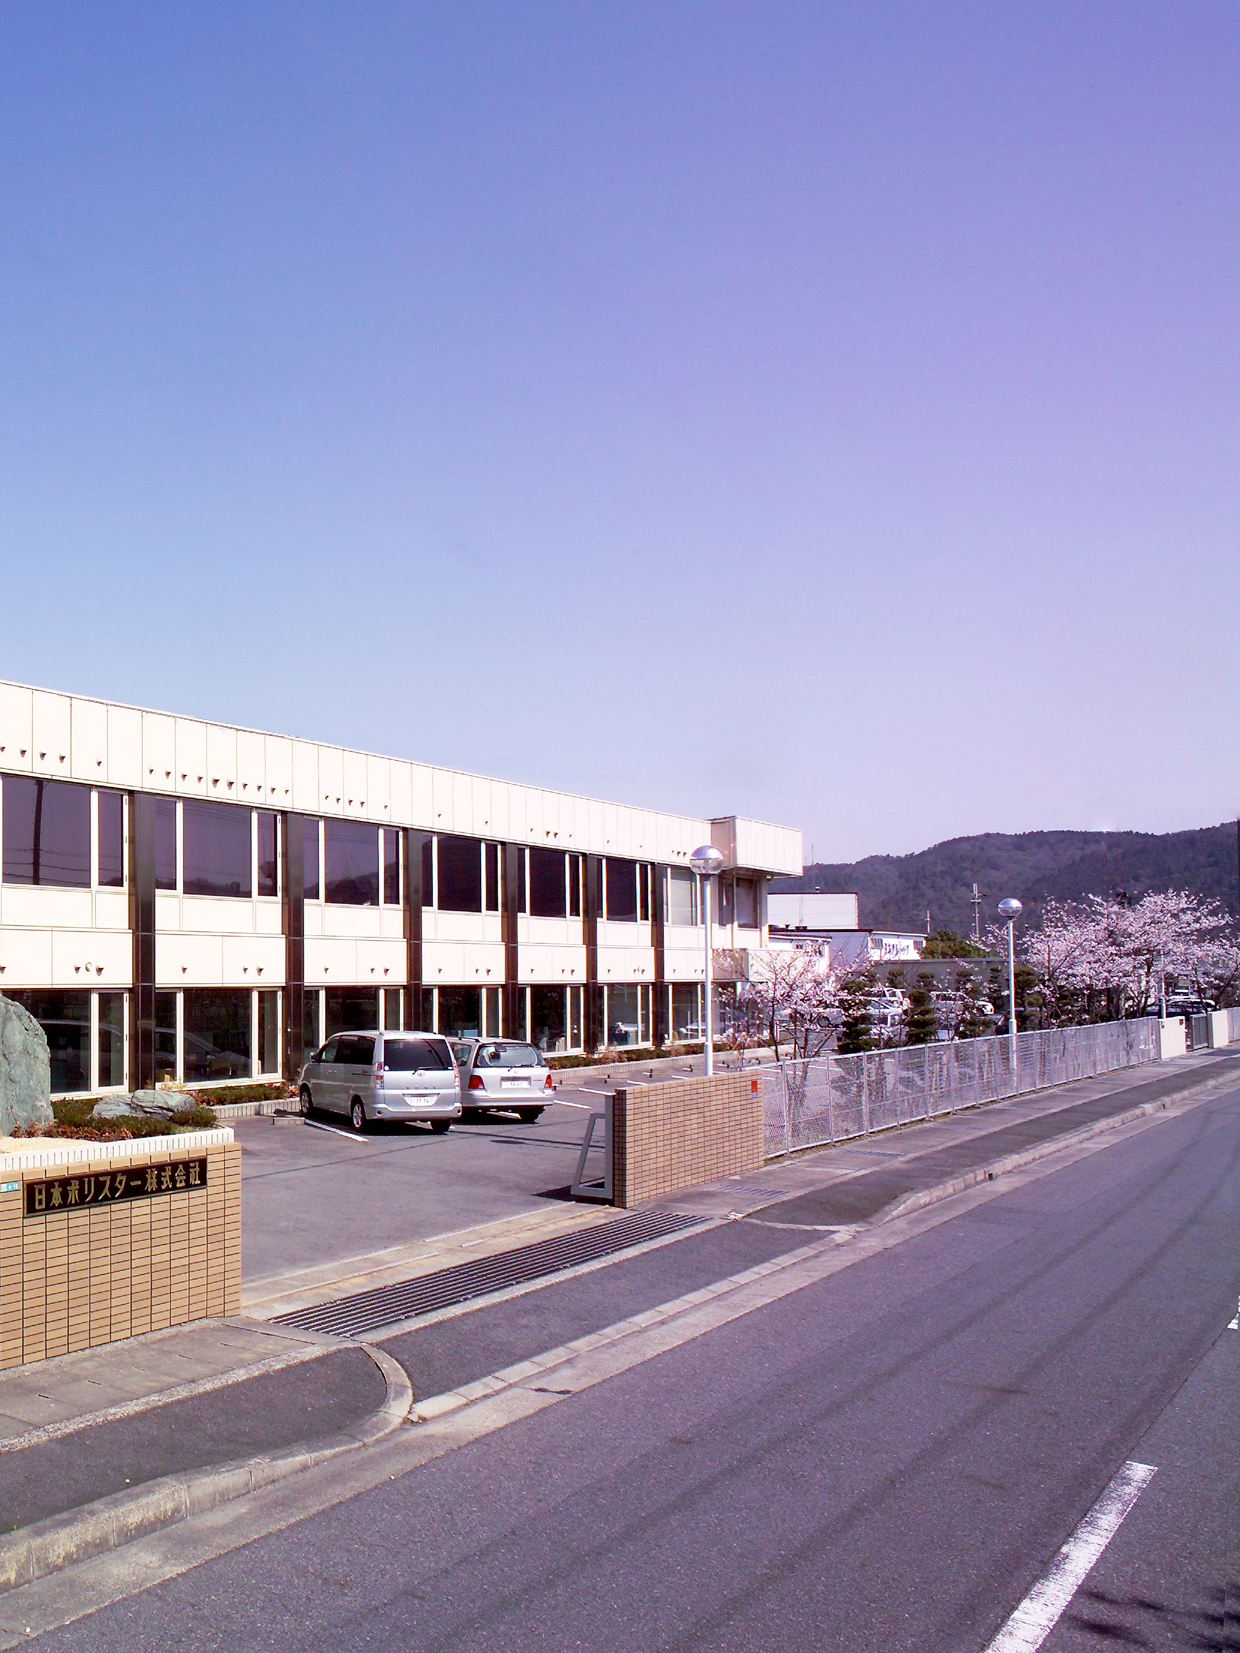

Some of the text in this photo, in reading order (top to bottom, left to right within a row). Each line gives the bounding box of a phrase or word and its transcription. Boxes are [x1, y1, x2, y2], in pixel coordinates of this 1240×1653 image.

[34, 1162, 201, 1210] 日本ポリスター株式会社
